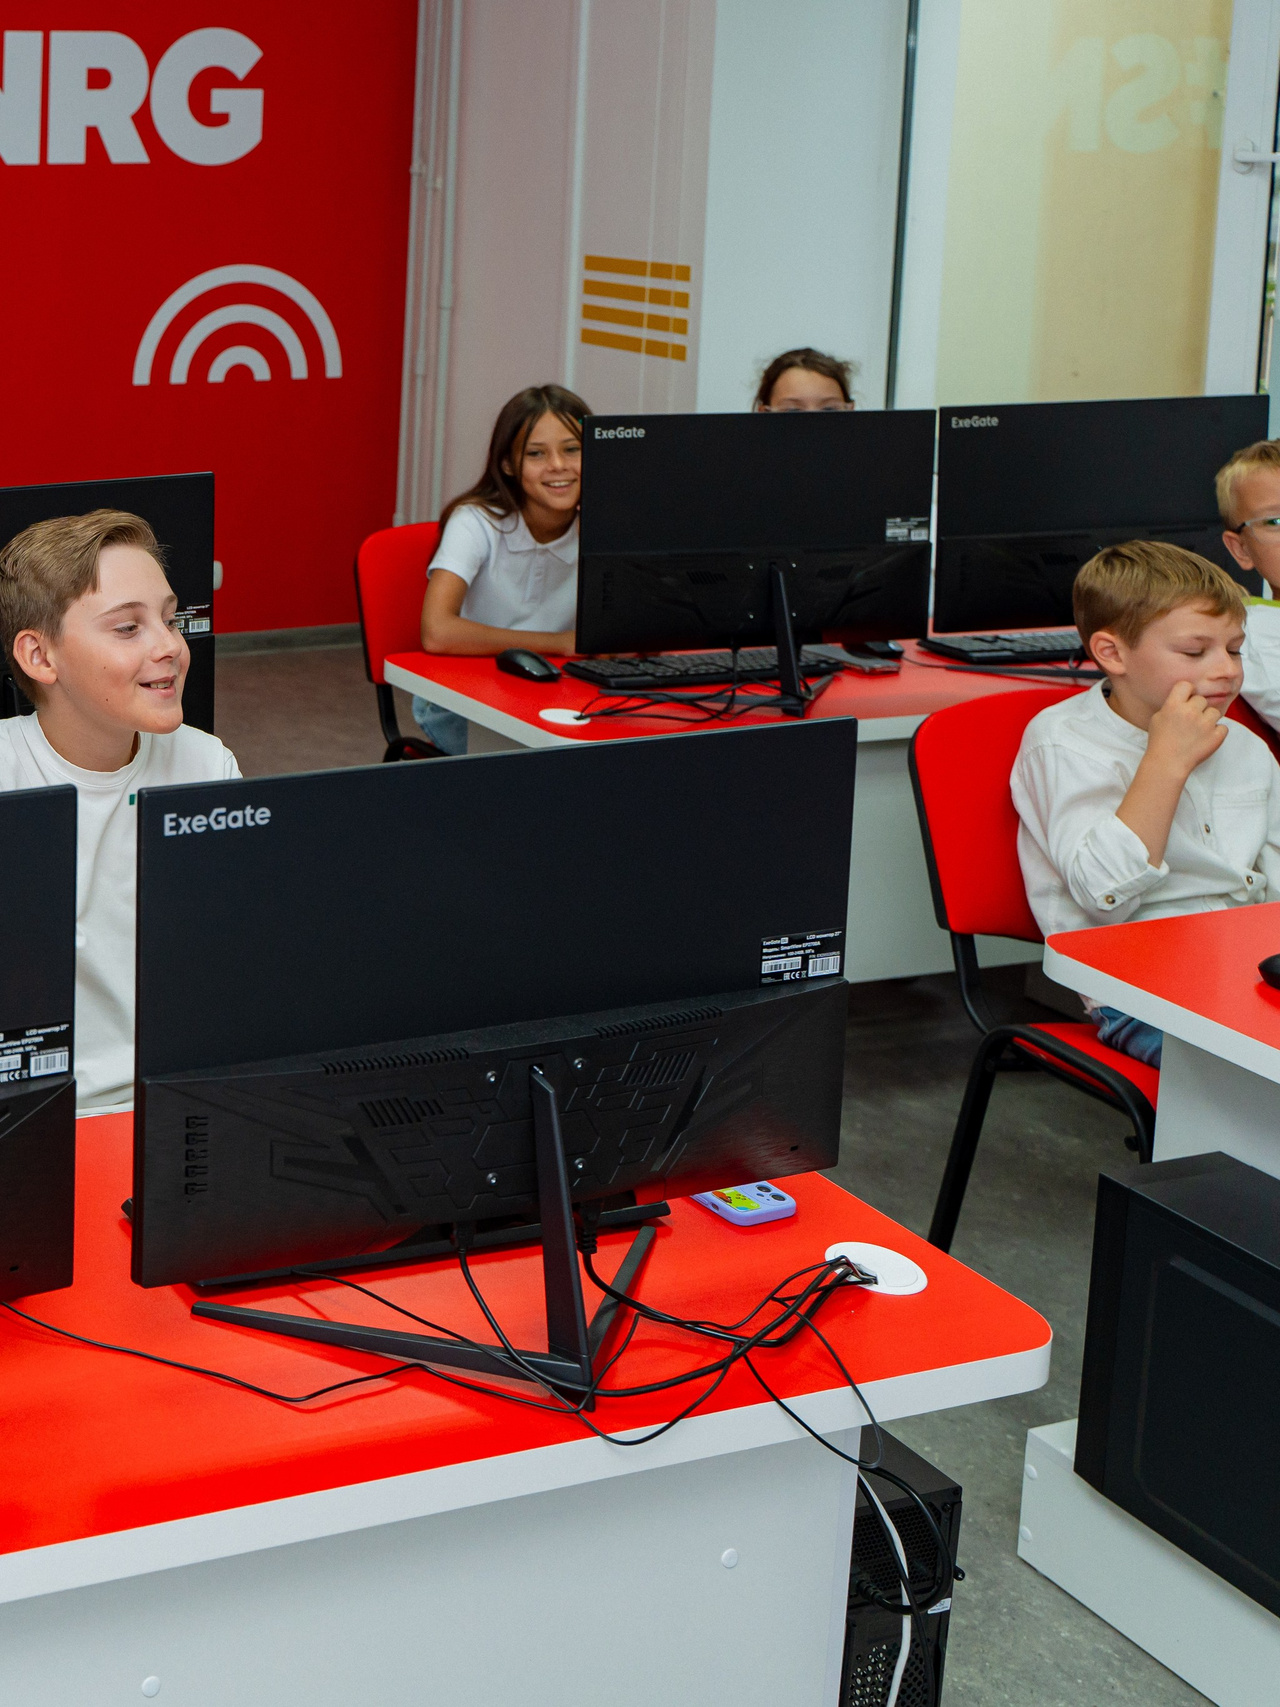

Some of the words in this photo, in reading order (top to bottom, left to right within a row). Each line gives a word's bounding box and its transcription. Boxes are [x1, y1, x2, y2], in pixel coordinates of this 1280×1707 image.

[951, 415, 1000, 429] ExeGate
[594, 426, 646, 440] ExeGate
[163, 804, 272, 837] ExeGate
